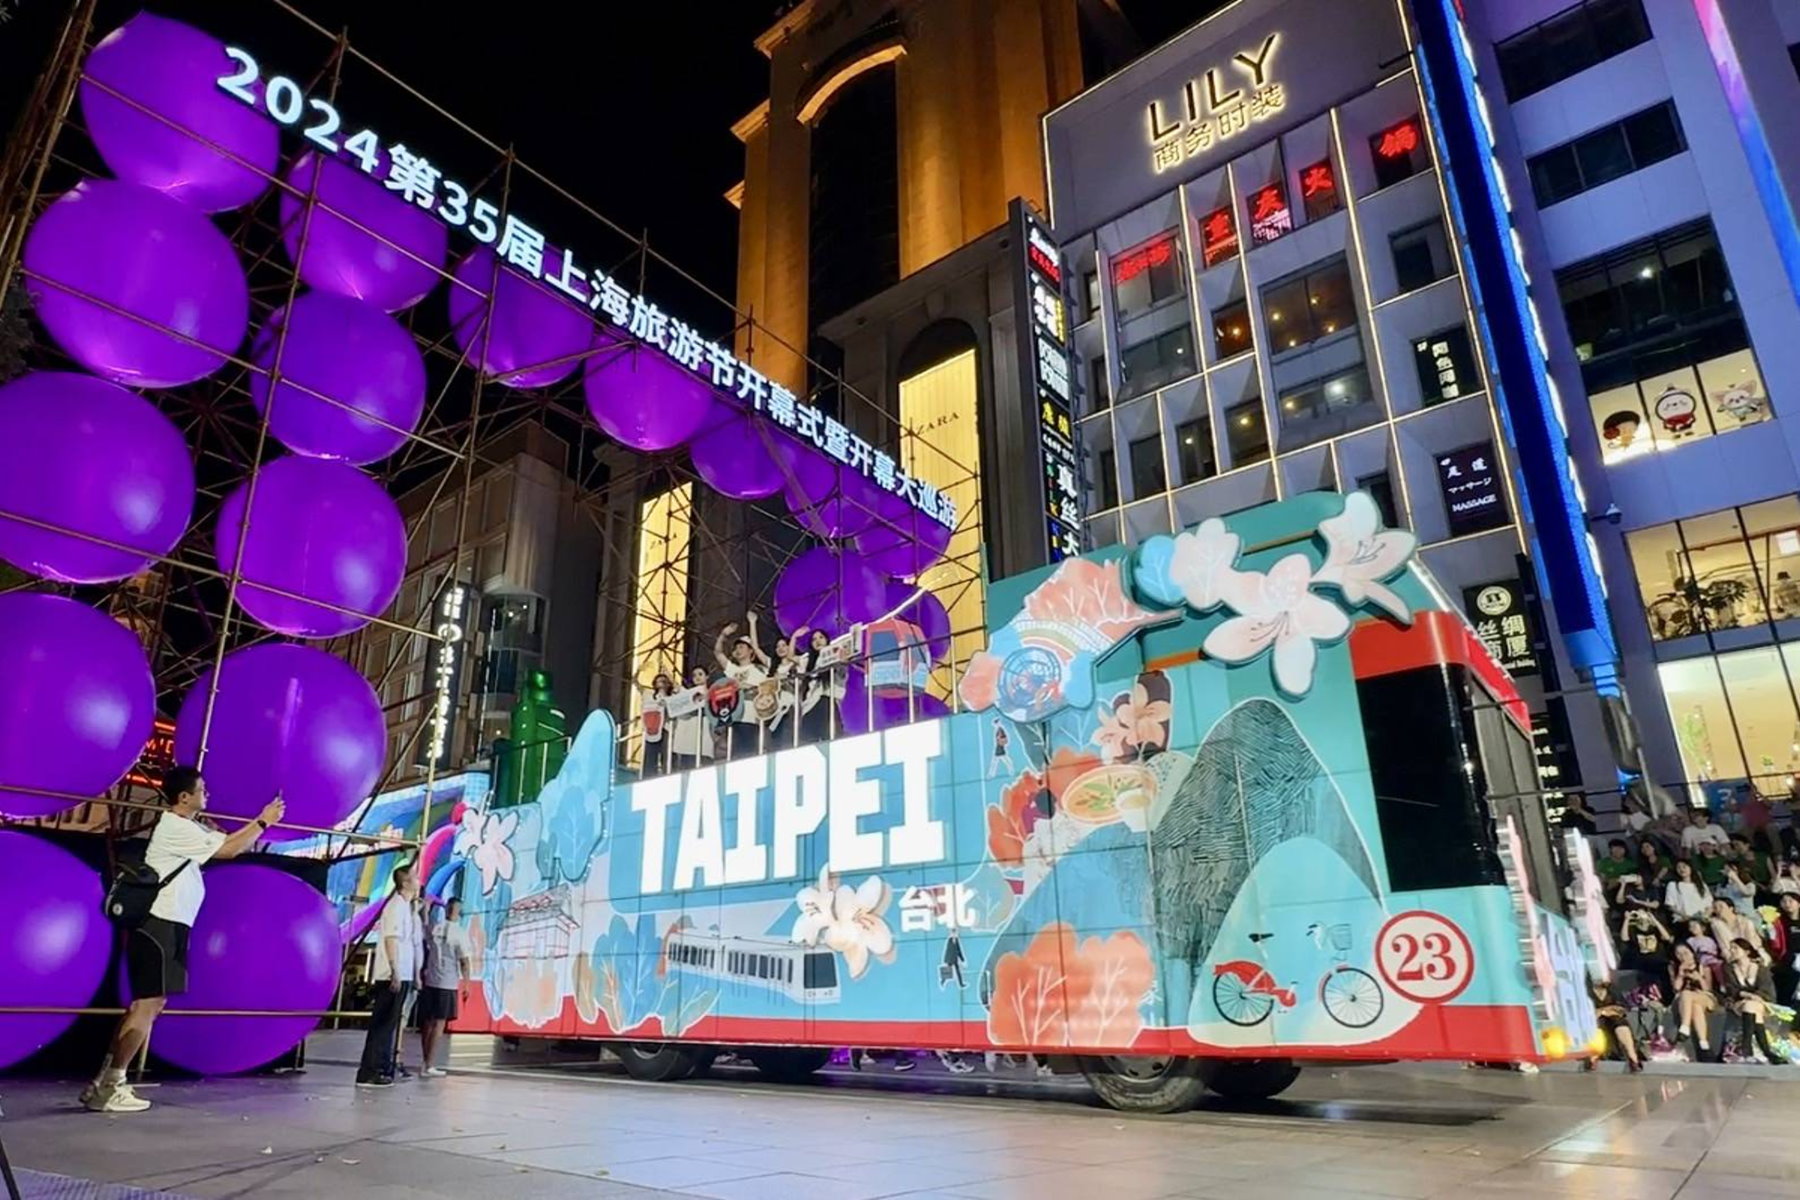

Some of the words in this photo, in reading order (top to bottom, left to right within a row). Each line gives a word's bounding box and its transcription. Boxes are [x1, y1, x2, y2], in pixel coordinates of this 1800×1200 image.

[1148, 33, 1278, 143] LILY
[1154, 87, 1285, 171] 商务时装
[1452, 494, 1497, 512] MASSAGE
[1478, 614, 1526, 642] 丝绸
[631, 720, 946, 895] TAIPEI
[898, 883, 976, 932] 台北
[1391, 933, 1457, 981] 23
